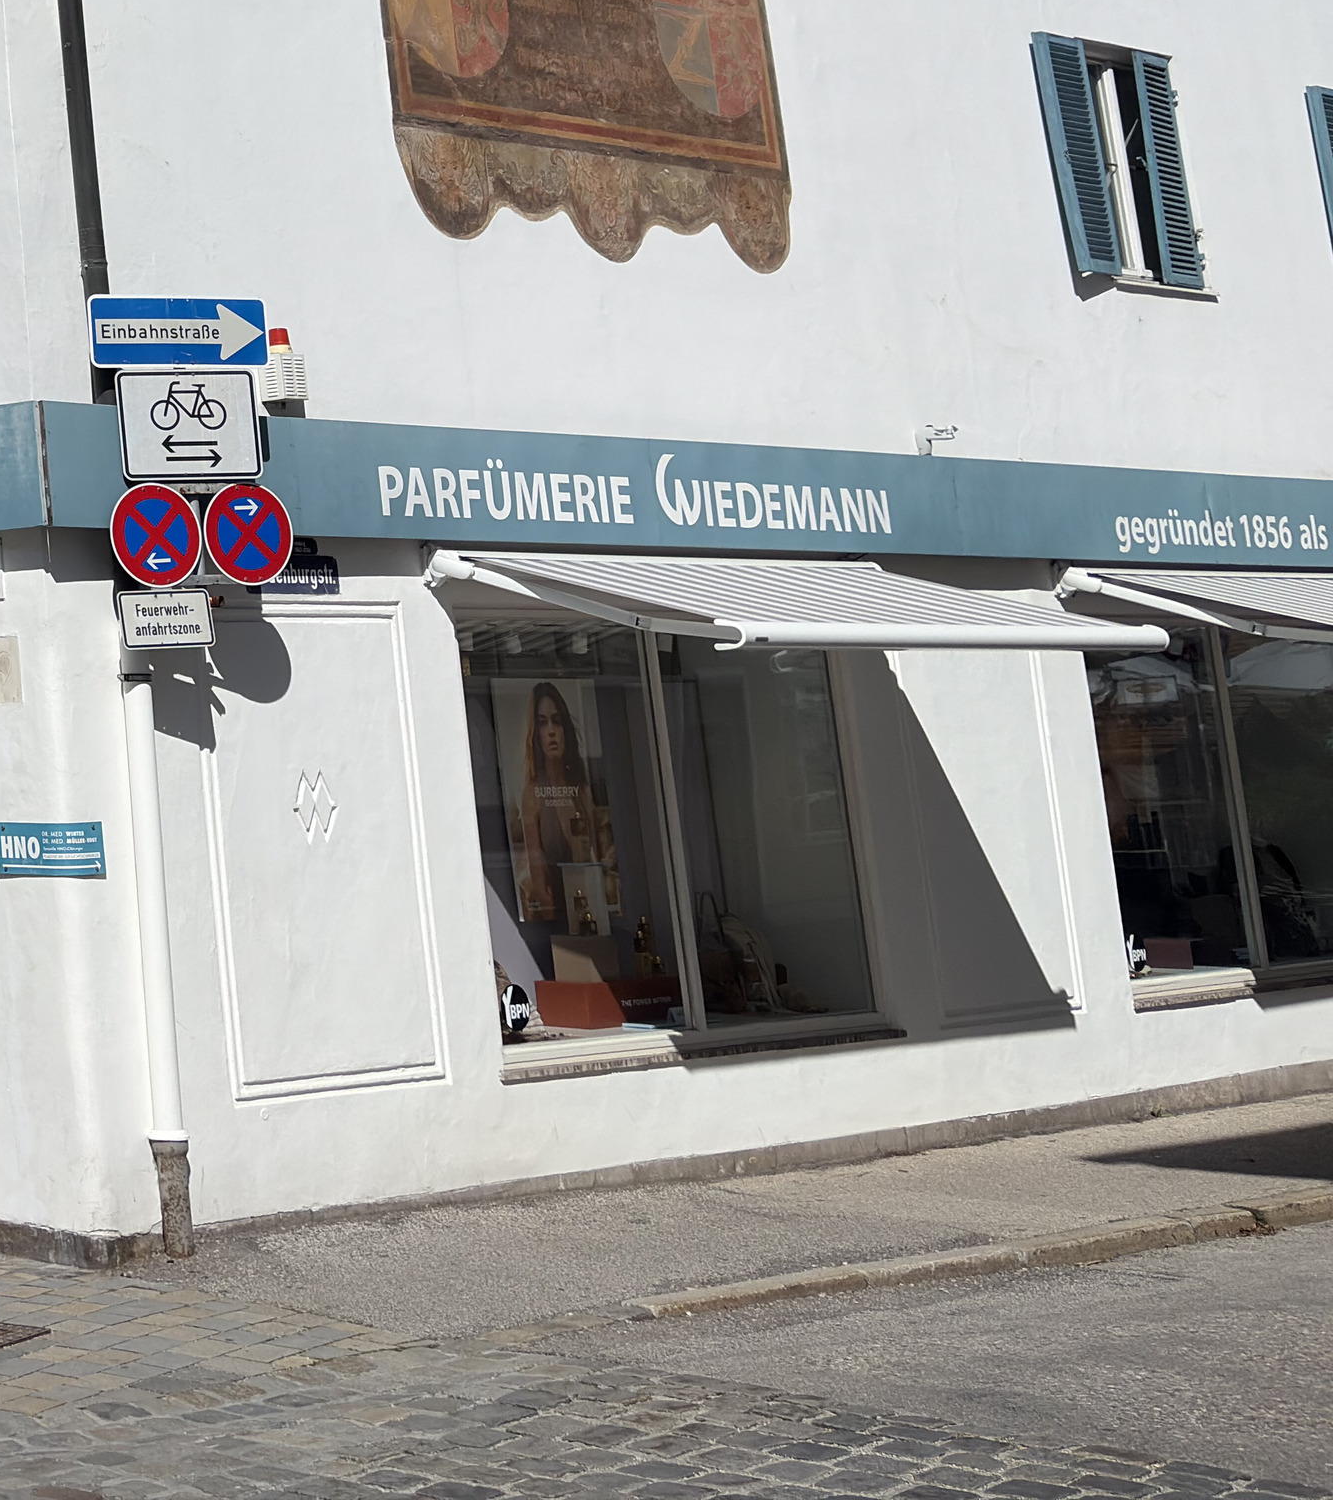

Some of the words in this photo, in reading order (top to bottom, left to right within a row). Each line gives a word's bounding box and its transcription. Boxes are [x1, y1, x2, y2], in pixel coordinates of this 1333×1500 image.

[101, 324, 220, 340] Einbahnstraße
[378, 458, 634, 524] PARFÜMERIE
[655, 453, 892, 534] WIEDEMANN
[1115, 508, 1236, 554] gegründet
[1239, 514, 1292, 549] 1856
[1299, 514, 1328, 550] als
[269, 563, 336, 589] enburgstr.
[135, 602, 195, 617] Feuerwehr-
[135, 622, 201, 636] anfahrtszone
[534, 786, 579, 798] BURBERRY
[0, 835, 40, 859] HNO
